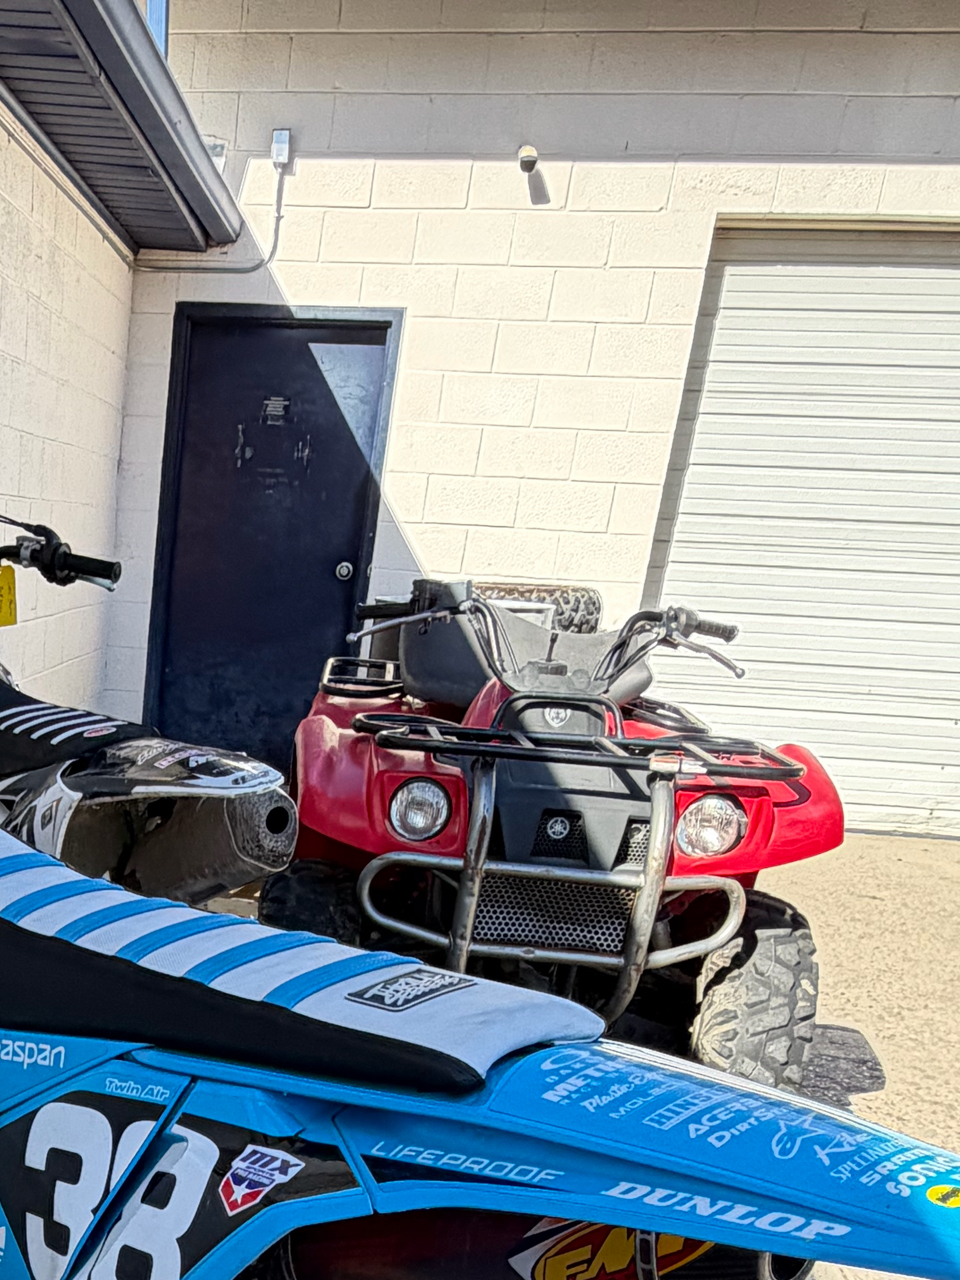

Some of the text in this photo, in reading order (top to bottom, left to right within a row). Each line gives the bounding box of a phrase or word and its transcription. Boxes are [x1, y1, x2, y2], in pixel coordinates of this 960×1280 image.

[105, 1077, 170, 1102] Twin Air
[239, 1149, 302, 1177] MX
[370, 1141, 565, 1183] LIFEPROOF
[601, 1181, 851, 1239] DUNLOP
